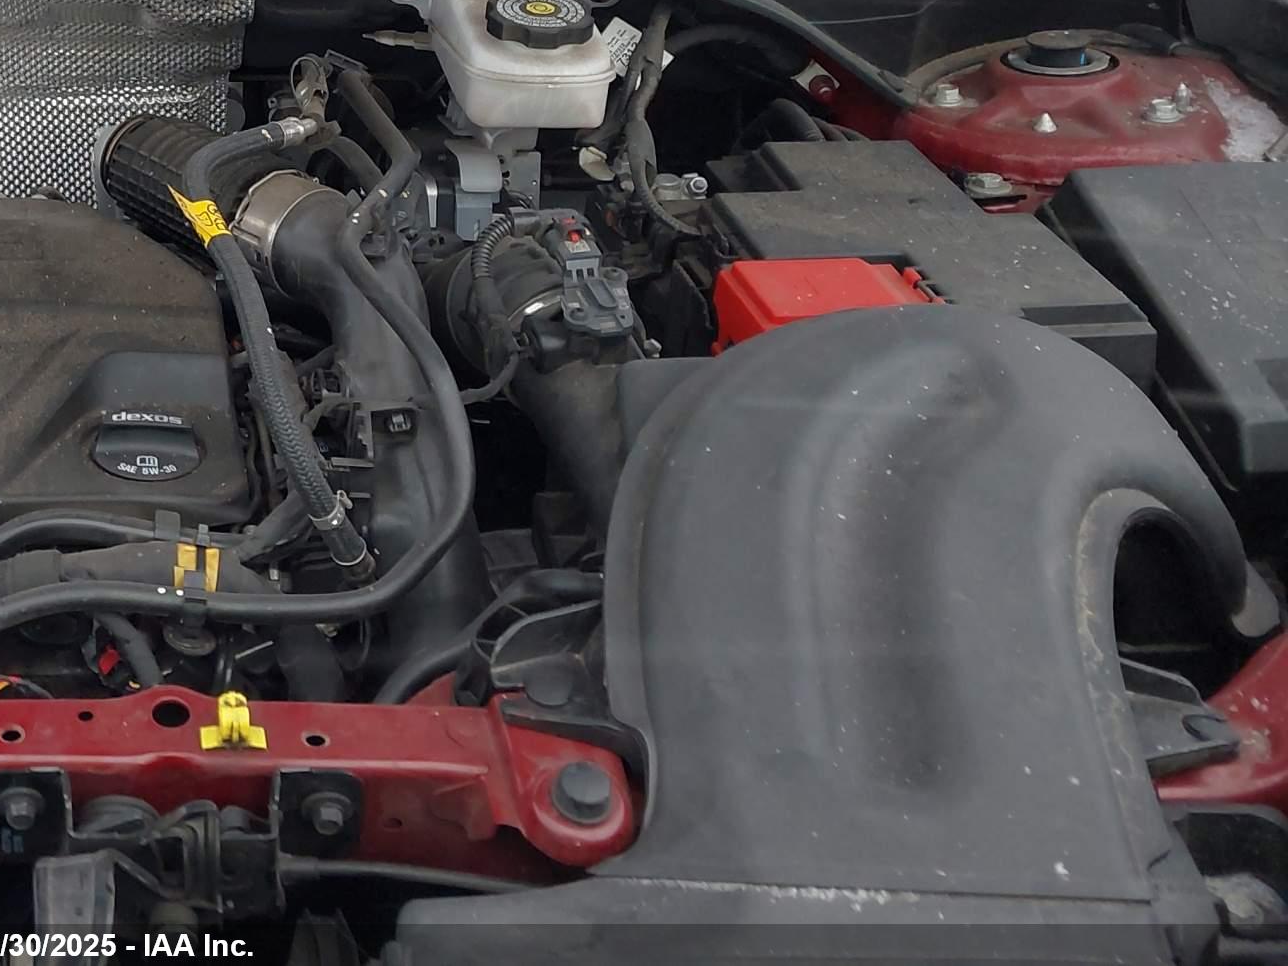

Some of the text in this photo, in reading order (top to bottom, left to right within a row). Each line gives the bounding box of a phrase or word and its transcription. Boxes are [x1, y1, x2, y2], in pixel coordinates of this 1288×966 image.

[111, 411, 182, 424] dexos
[116, 462, 177, 475] SAE 5W-30
